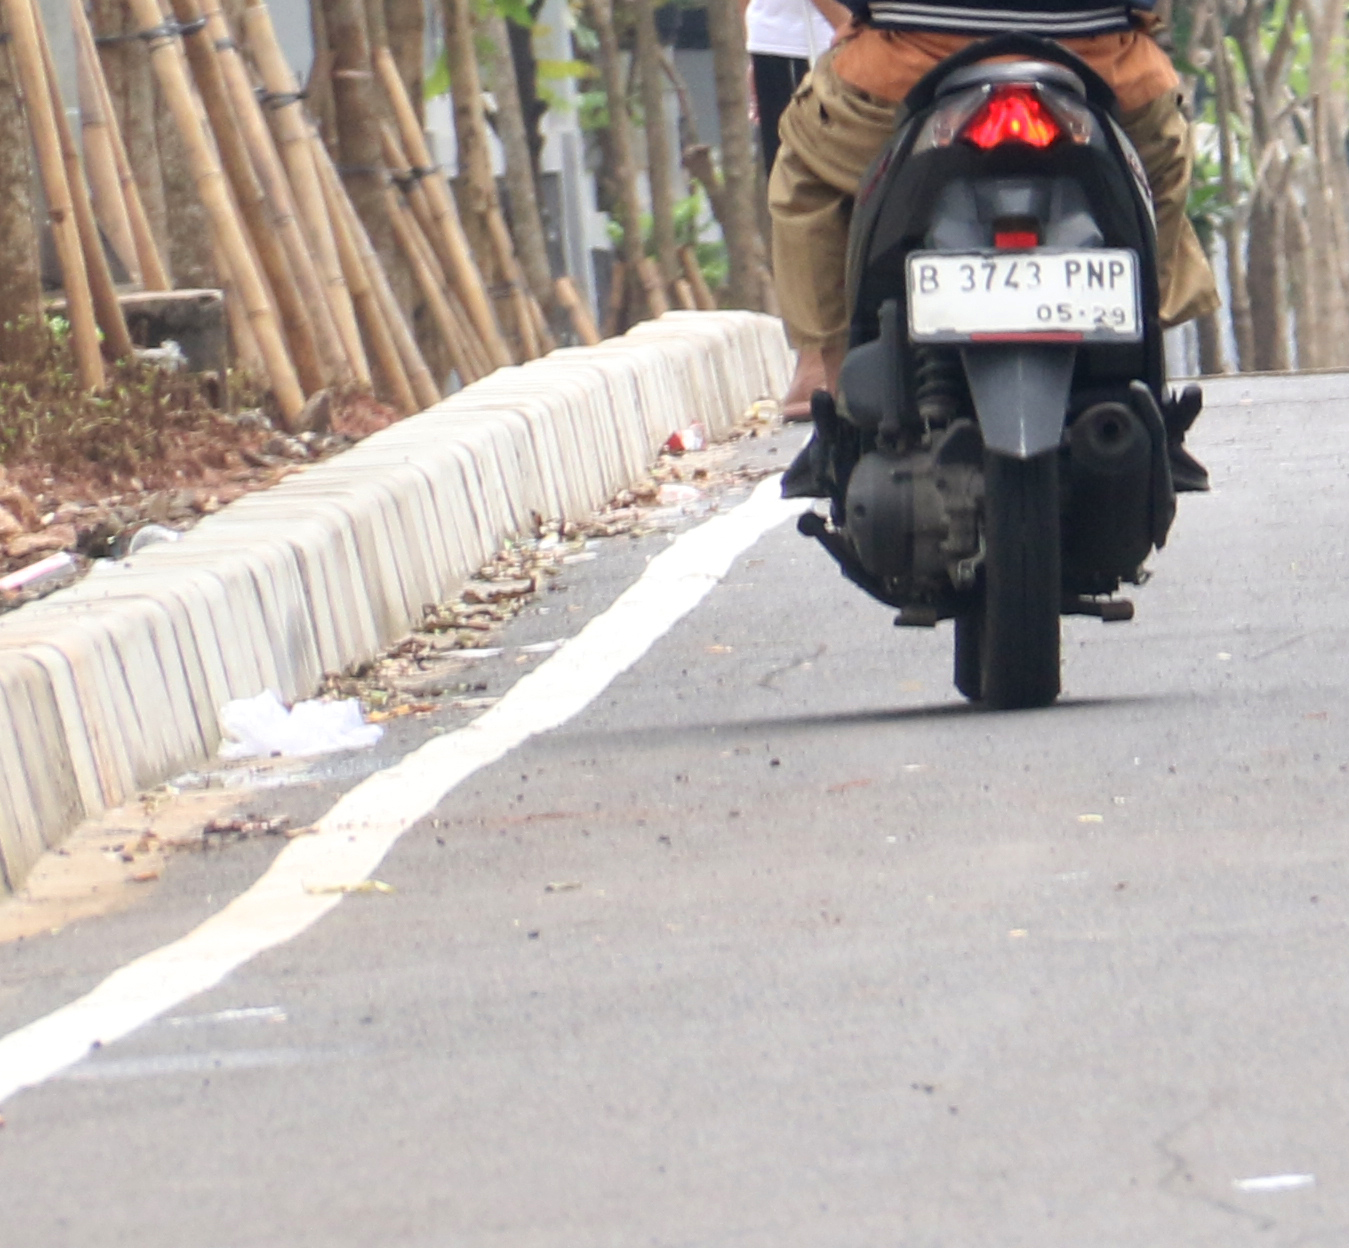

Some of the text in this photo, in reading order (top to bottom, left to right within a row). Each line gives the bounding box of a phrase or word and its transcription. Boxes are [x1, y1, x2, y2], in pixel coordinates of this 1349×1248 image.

[919, 260, 1125, 294] B 3743 PNP
